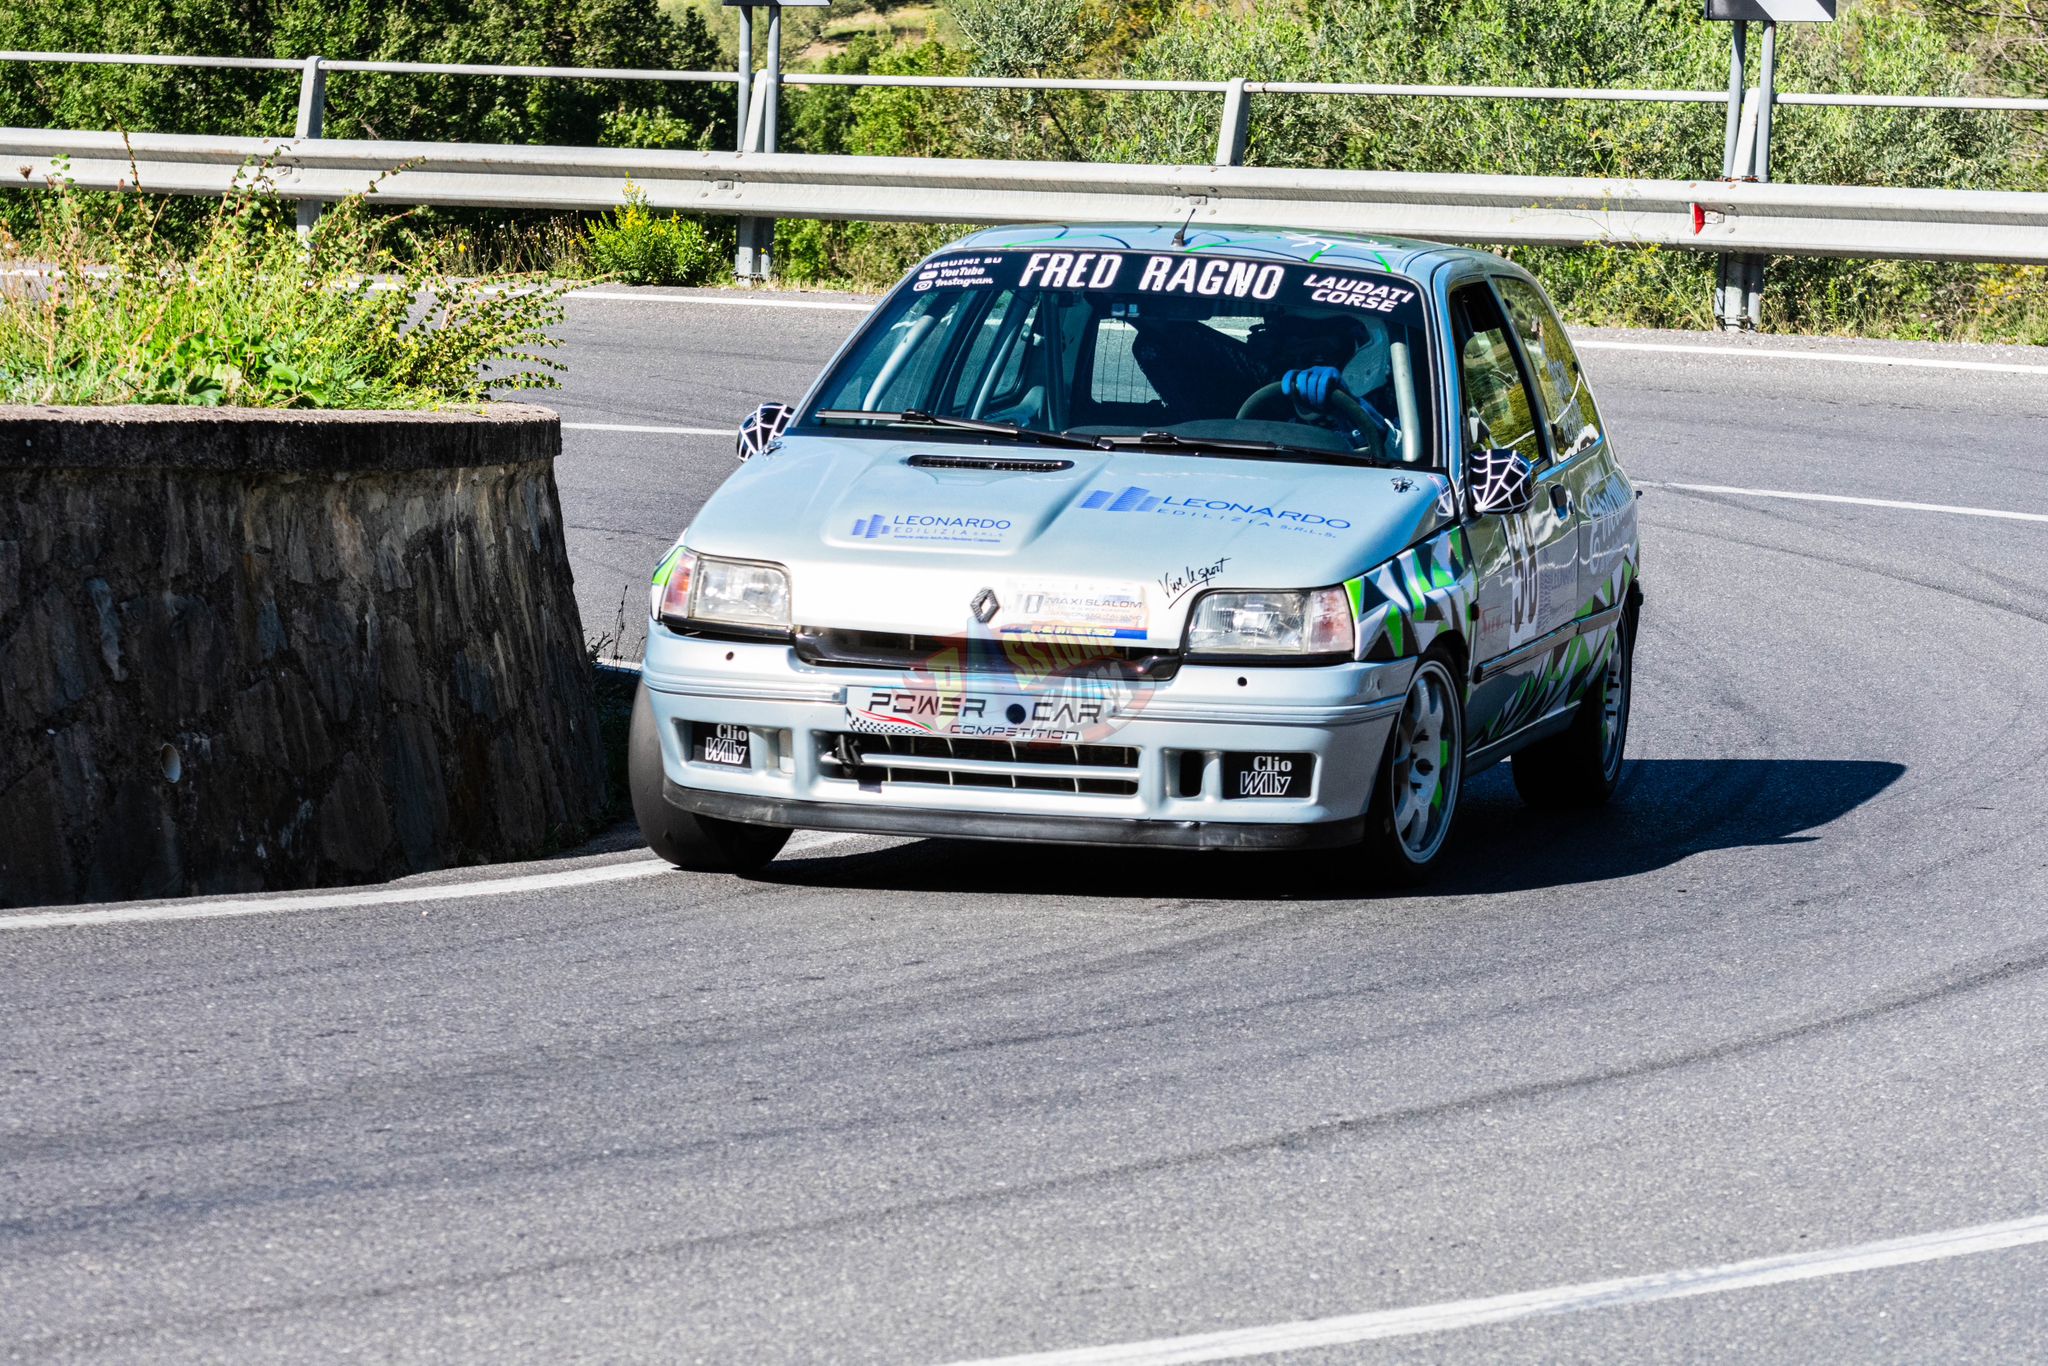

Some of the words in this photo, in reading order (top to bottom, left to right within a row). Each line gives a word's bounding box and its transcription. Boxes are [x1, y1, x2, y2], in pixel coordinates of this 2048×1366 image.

[940, 267, 985, 278] YouTube
[1018, 252, 1123, 289] FRED
[1138, 255, 1285, 300] RAGNO
[935, 278, 994, 288] Instagram
[1303, 274, 1415, 303] LAUDATI
[1311, 289, 1398, 313] CORSE
[1156, 508, 1271, 527] EDILIZIA
[1163, 496, 1351, 530] LEONARDO
[893, 515, 1012, 530] LEONARDO
[894, 526, 968, 536] EDILIZIA
[1084, 598, 1143, 609] SLALOM
[868, 692, 987, 718] POWER
[1031, 702, 1102, 724] CAR
[716, 723, 748, 741] Clio
[950, 725, 1079, 741] COMPETITION
[1253, 755, 1292, 772] Clio
